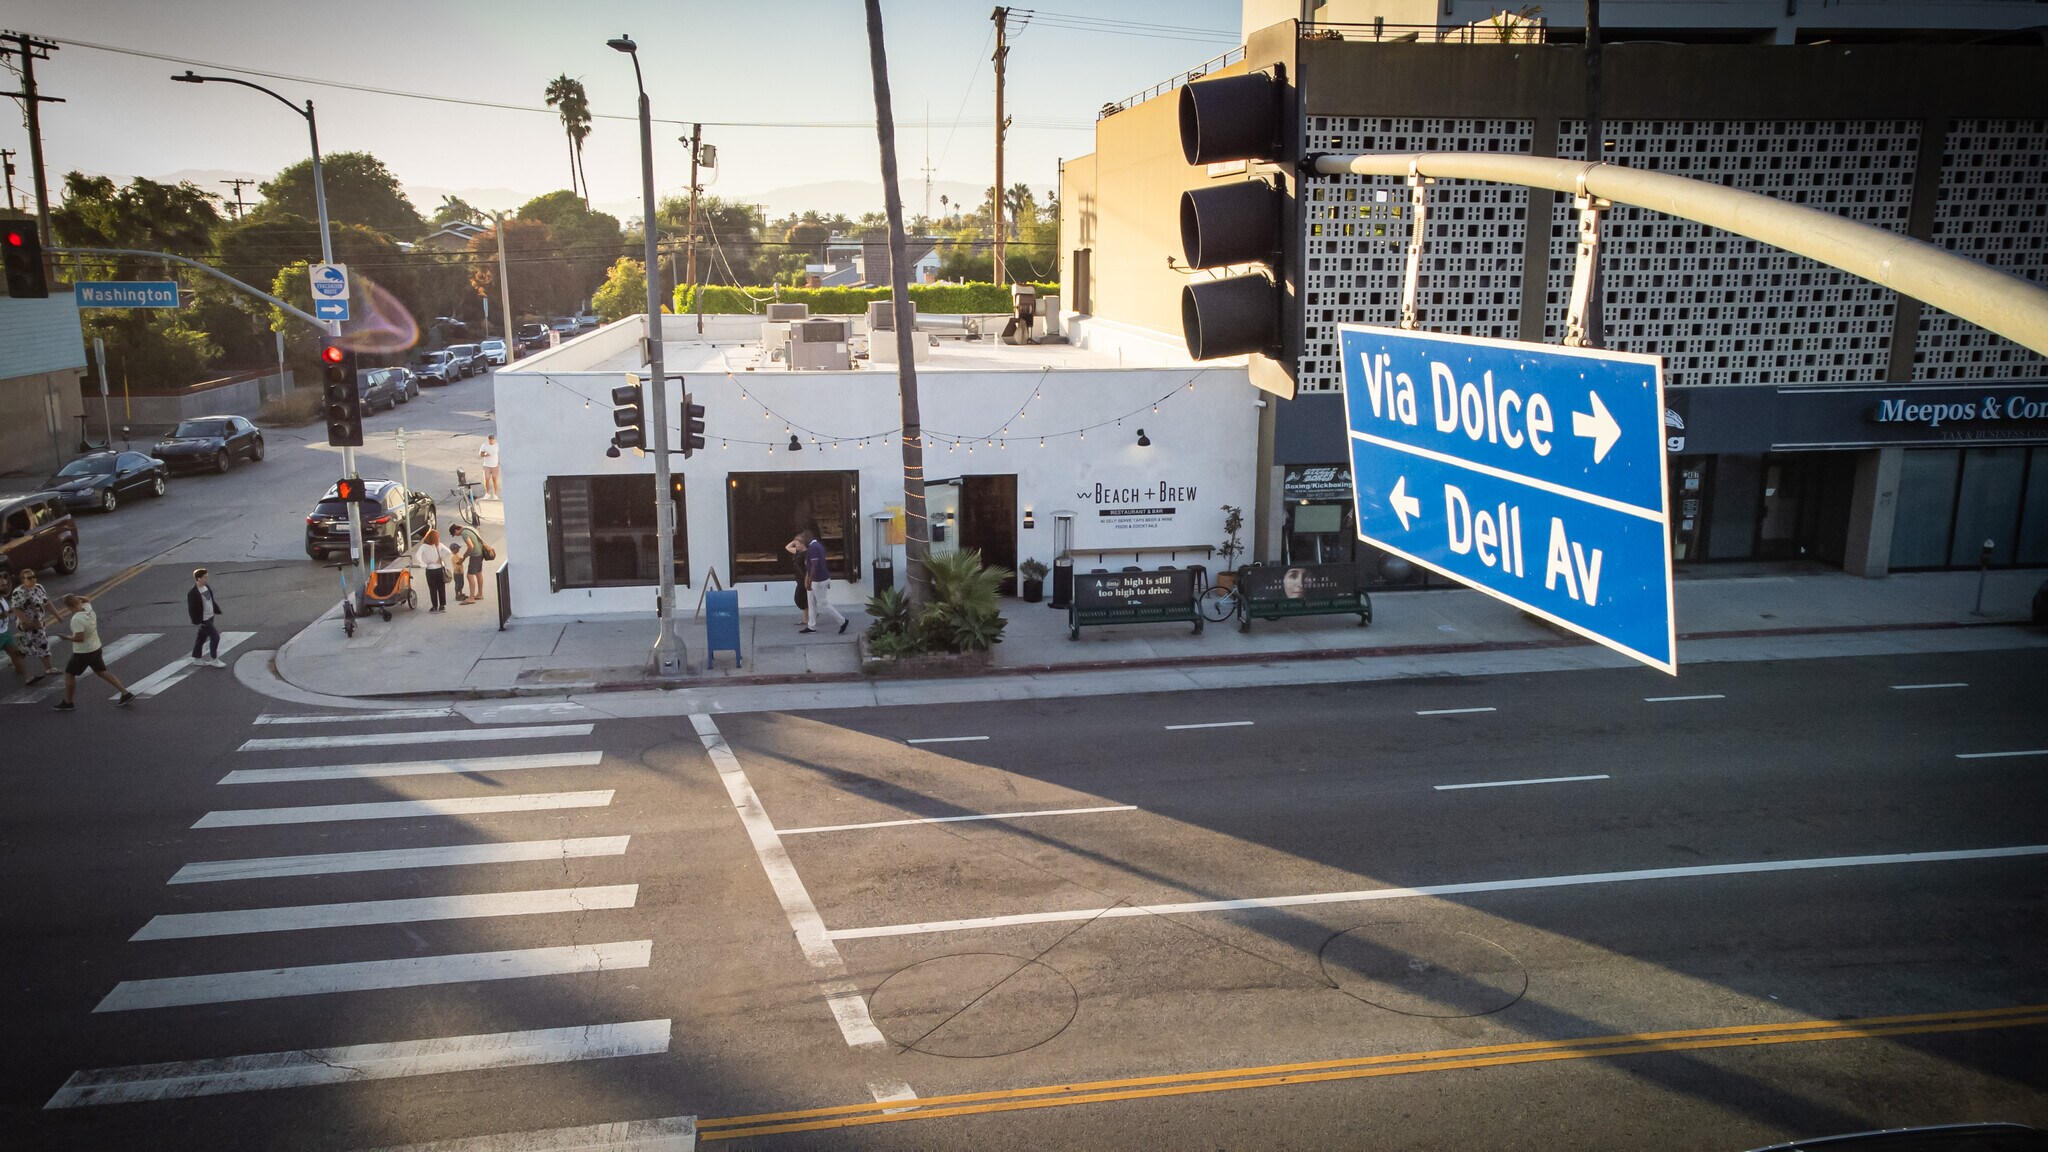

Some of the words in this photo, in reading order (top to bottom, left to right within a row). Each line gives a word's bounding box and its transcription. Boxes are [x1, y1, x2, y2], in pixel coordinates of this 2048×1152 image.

[82, 287, 171, 305] Washington
[1361, 352, 1418, 426] Via
[1430, 361, 1554, 457] Dolce
[1880, 399, 1976, 427] Meepos
[1981, 396, 2002, 419] &
[1942, 431, 1965, 440] TAX
[1095, 482, 1139, 504] BEACH
[1160, 480, 1197, 502] BREW
[1444, 484, 1524, 578] Dell
[1545, 517, 1602, 607] Av
[1098, 589, 1113, 597] too
[1115, 588, 1135, 598] high
[1137, 588, 1146, 596] to
[1148, 587, 1172, 595] drive.
[1124, 577, 1144, 588] high
[1146, 577, 1153, 585] is
[1155, 576, 1171, 585] still
